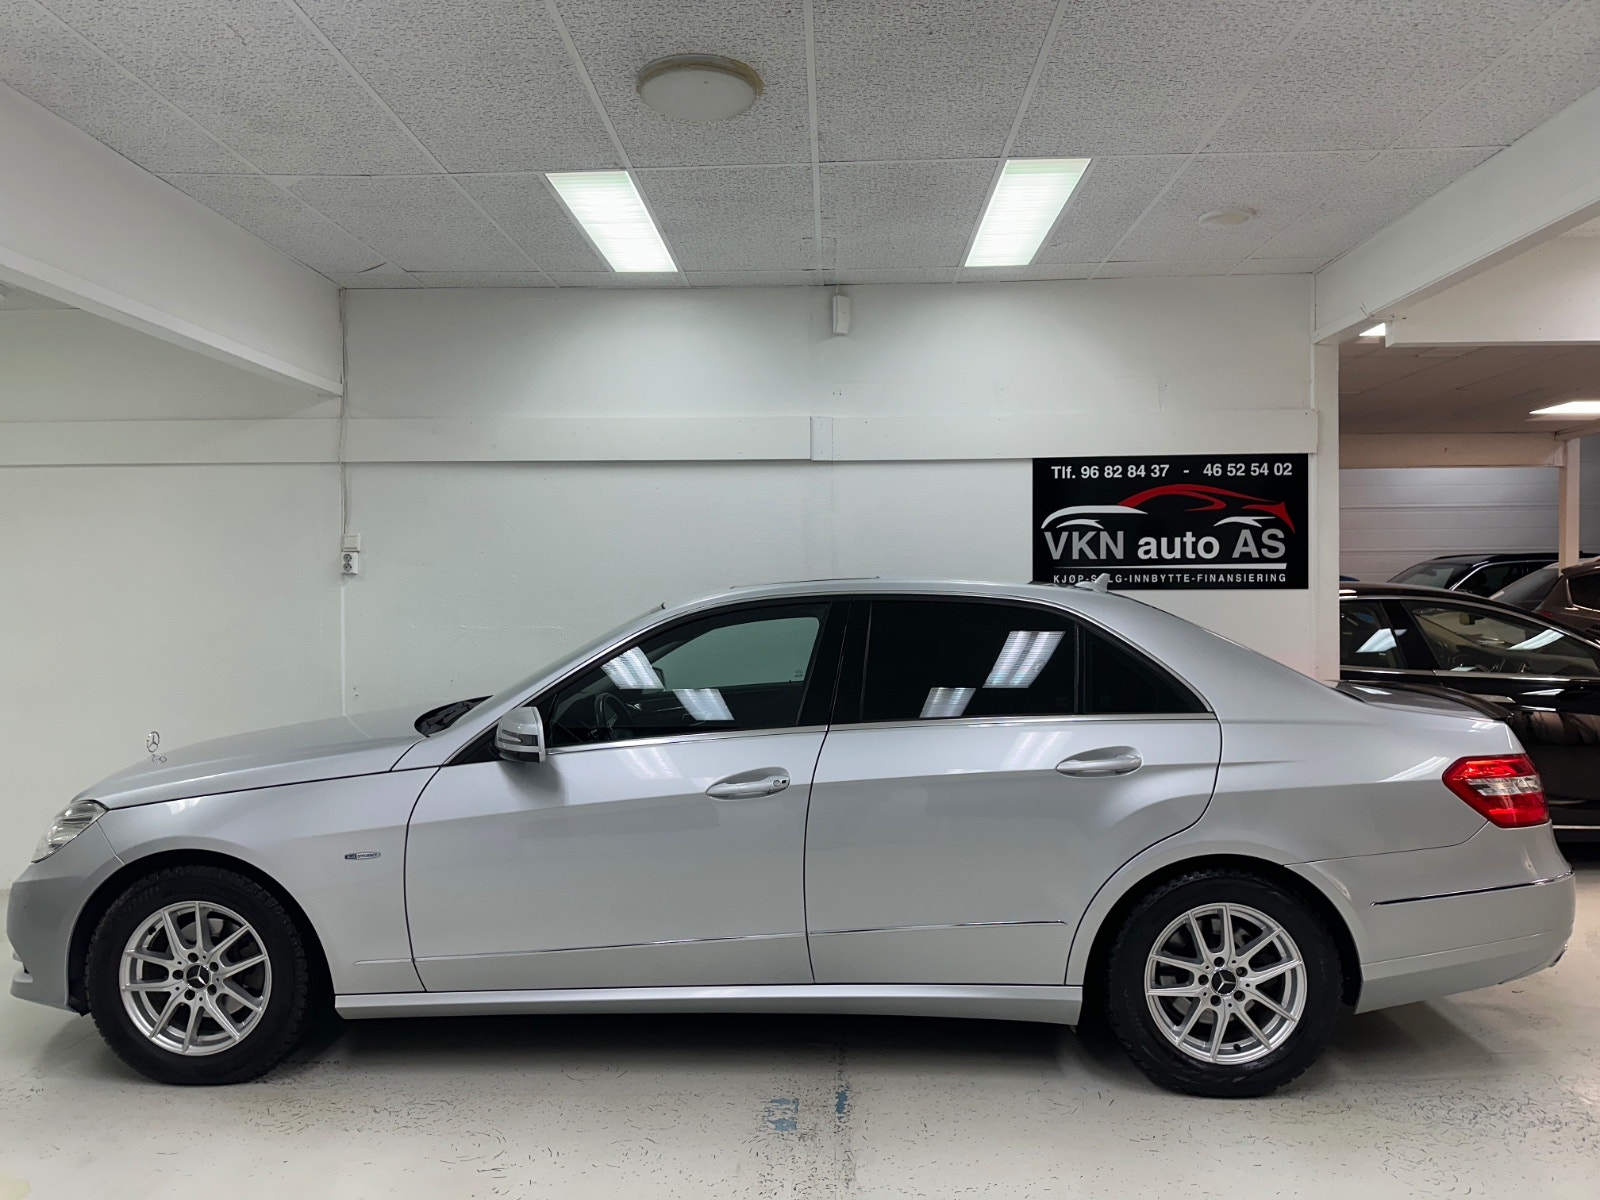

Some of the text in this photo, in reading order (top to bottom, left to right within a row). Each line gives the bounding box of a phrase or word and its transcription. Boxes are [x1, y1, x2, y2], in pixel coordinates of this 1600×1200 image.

[1051, 465, 1076, 479] Tlf.
[1080, 464, 1099, 478] 96
[1104, 464, 1122, 478] 82
[1127, 463, 1146, 477] 84
[1150, 463, 1169, 477] 37
[1203, 463, 1222, 476] 46
[1226, 463, 1245, 476] 52
[1250, 462, 1269, 476] 54
[1274, 462, 1292, 475] 02
[1044, 529, 1286, 560] VKN auto AS
[1053, 573, 1286, 583] KJØP-SLG-INNBYTTE-FINANSIERING
